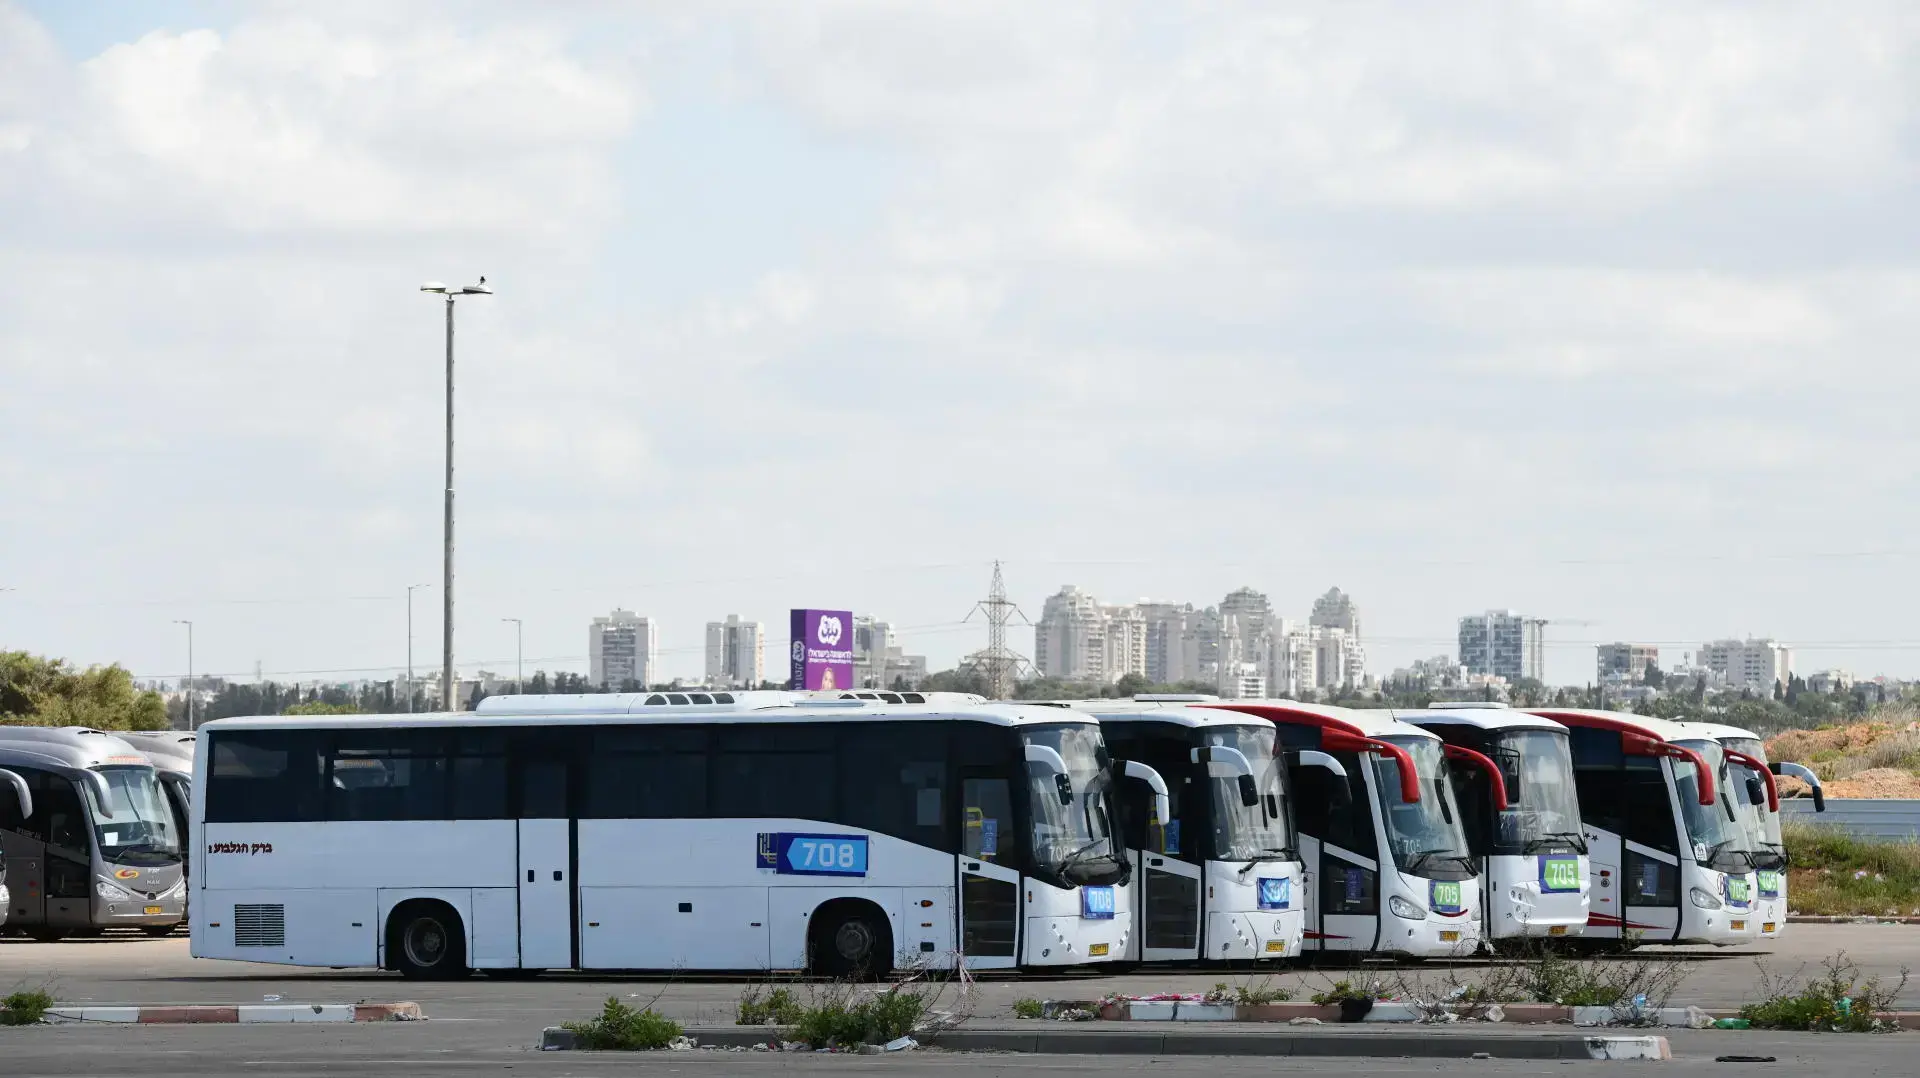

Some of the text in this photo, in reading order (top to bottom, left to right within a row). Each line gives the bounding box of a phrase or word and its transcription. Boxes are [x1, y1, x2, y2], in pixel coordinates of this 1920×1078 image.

[802, 842, 854, 868] 708
[1551, 863, 1575, 886] 705
[1761, 873, 1777, 889] 705
[1090, 891, 1112, 909] 708
[1438, 885, 1458, 903] 705
[1732, 882, 1747, 901] 705
